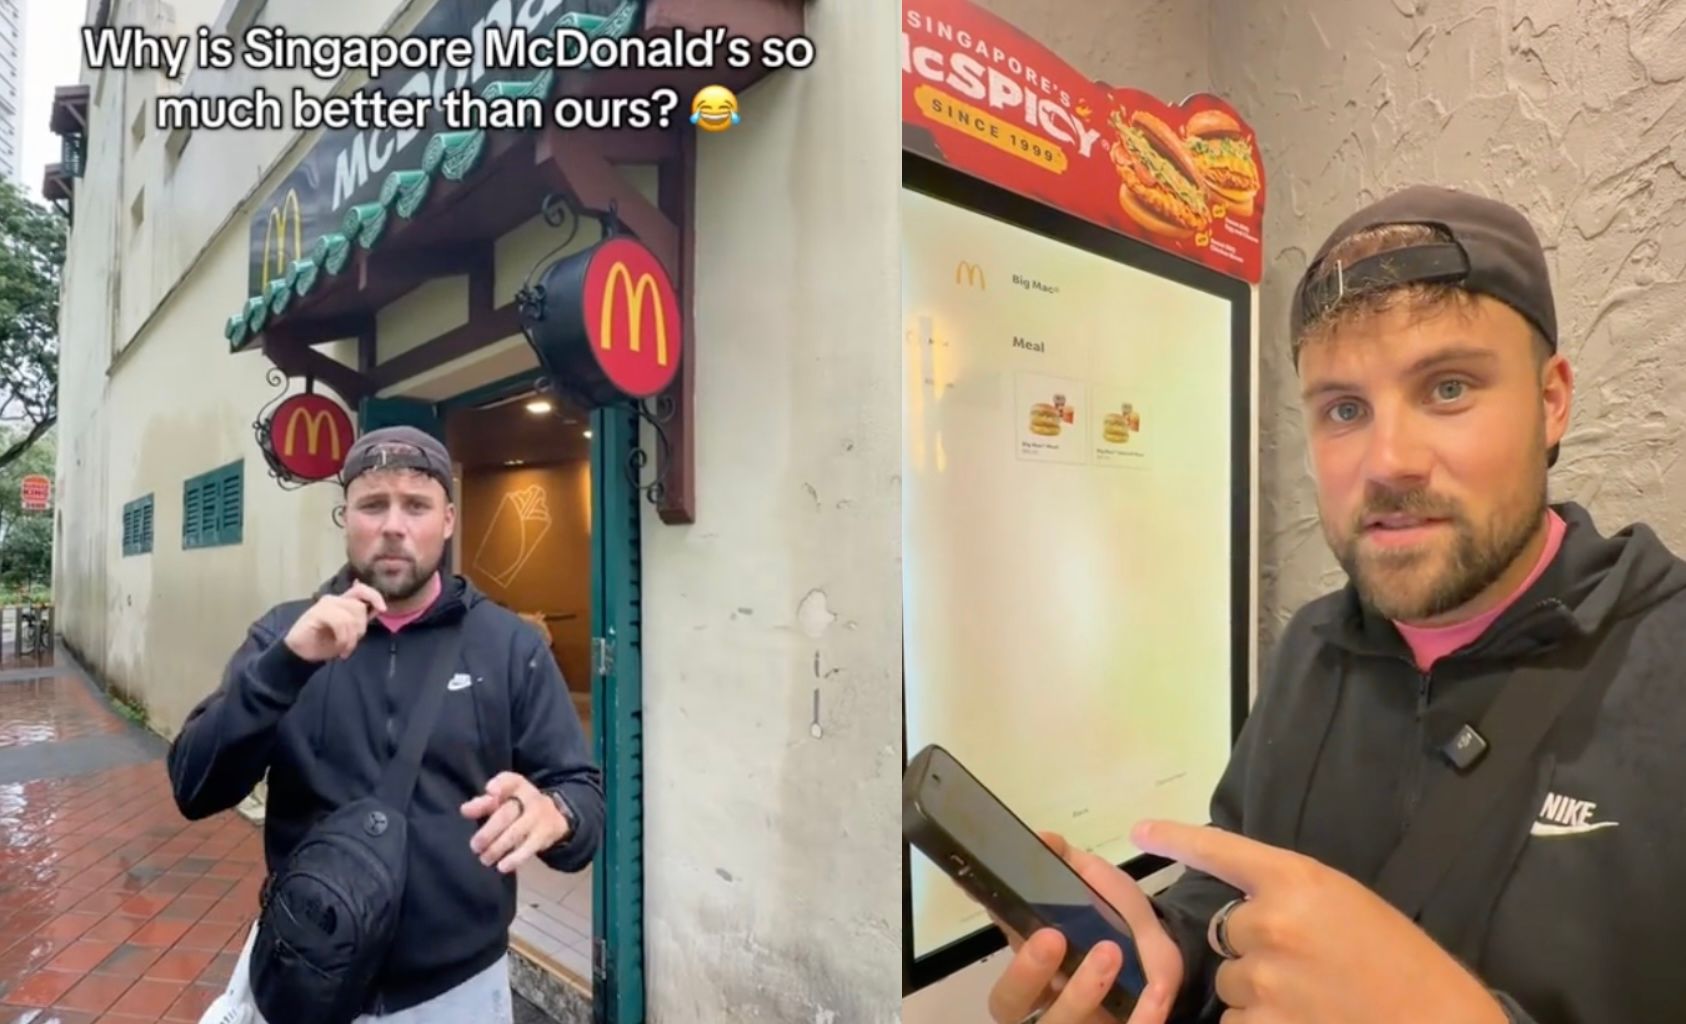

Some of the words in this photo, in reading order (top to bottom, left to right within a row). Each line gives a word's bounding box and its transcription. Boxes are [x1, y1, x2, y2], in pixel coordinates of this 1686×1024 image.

[906, 9, 1071, 108] SINGAPORE'S
[931, 98, 999, 139] SINCE
[1009, 134, 1053, 162] 1999
[1012, 273, 1030, 290] Big
[1012, 335, 1045, 353] Meal
[1539, 791, 1597, 826] NIKE
